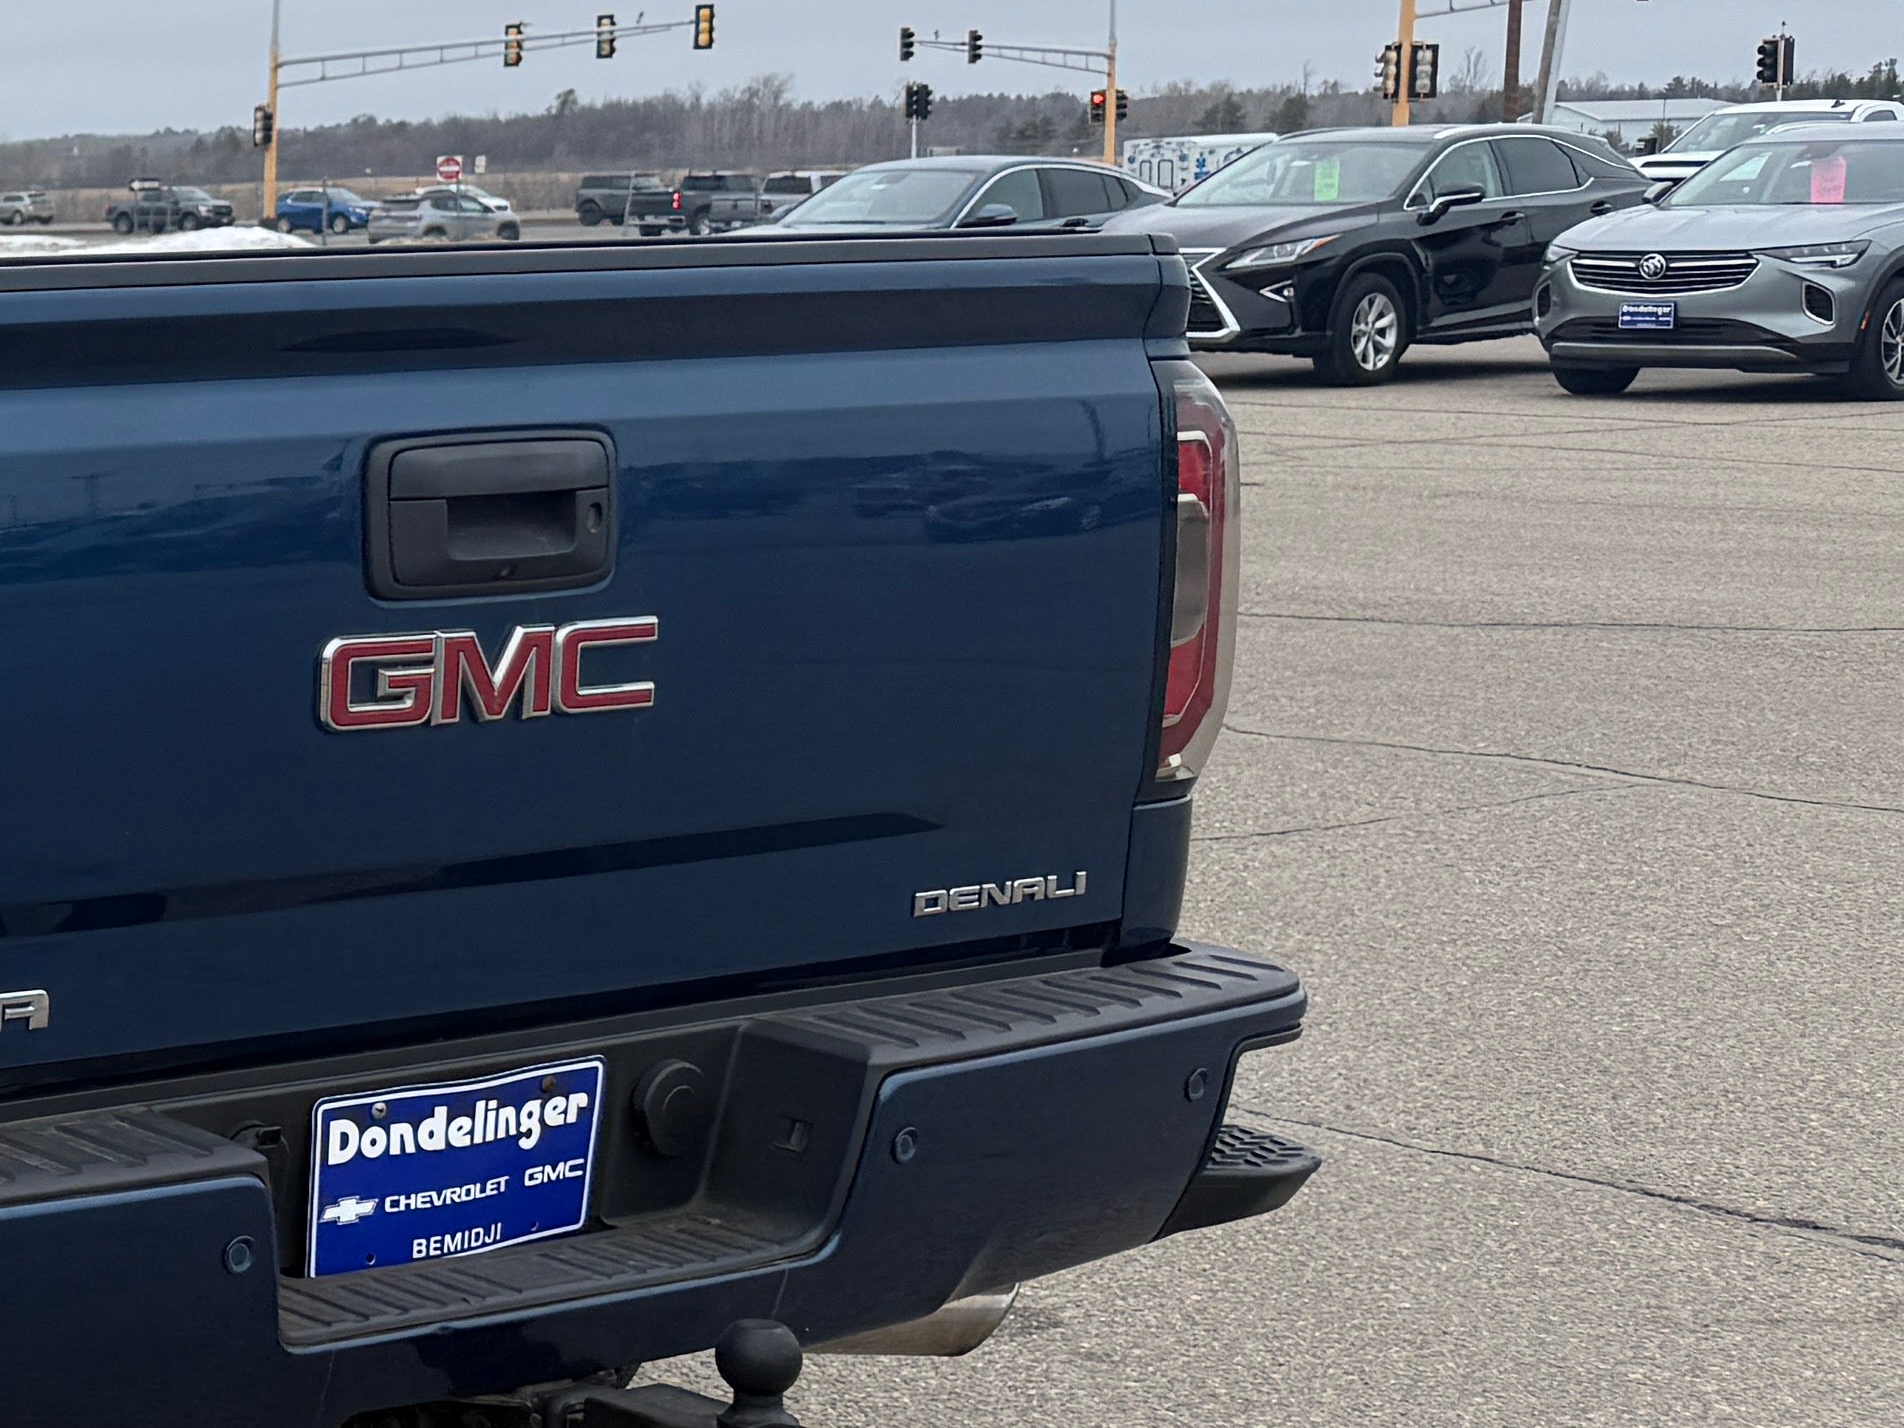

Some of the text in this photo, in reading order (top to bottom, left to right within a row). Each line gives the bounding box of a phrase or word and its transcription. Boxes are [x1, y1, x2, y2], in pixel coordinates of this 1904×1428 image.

[320, 615, 659, 731] GMC
[913, 871, 1087, 918] DENALI
[328, 1092, 589, 1166] Dondelinger
[384, 1158, 585, 1214] CHEVROLET GMC
[412, 1223, 503, 1259] BEMIDJI
